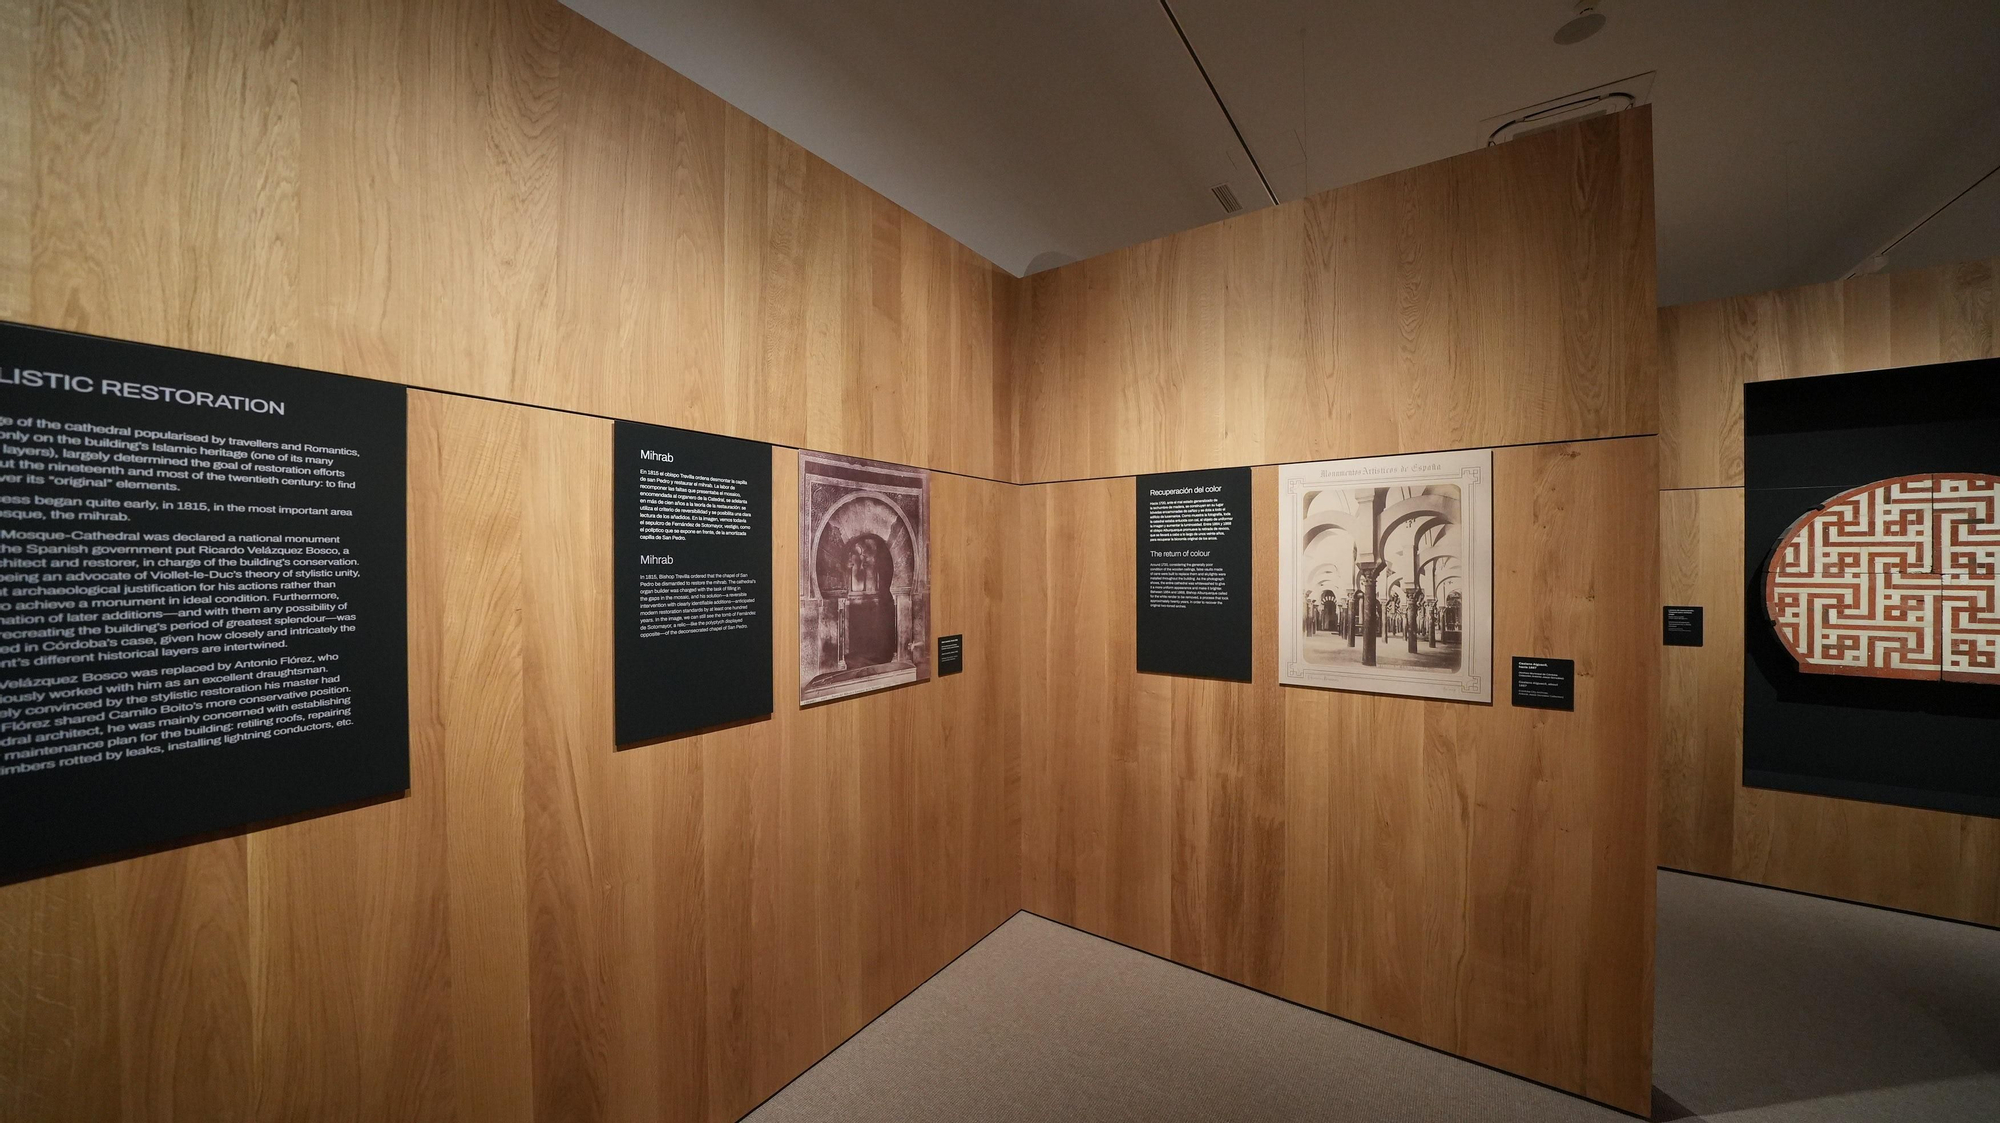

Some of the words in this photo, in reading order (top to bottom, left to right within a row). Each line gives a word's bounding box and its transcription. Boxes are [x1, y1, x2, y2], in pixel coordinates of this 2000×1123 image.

[102, 379, 285, 415] RESTORATION
[17, 417, 33, 427] of
[36, 419, 61, 430] the
[64, 423, 131, 436] cathedral
[134, 430, 209, 443] popularised
[212, 435, 226, 446] by
[228, 437, 279, 449] travellers
[281, 443, 302, 451] and
[304, 444, 360, 457] Romantics,
[3, 444, 59, 458] layers),
[63, 448, 111, 463] largely
[113, 453, 188, 466] determined
[191, 458, 211, 468] the
[213, 461, 238, 470] goal
[240, 462, 252, 470] of
[254, 465, 312, 475] restoration
[313, 465, 345, 477] efforts
[33, 434, 54, 443] on
[57, 434, 81, 445] the
[84, 436, 150, 452] building's
[153, 443, 197, 454] Islamic
[200, 446, 248, 460] heritage
[250, 451, 276, 461] (one
[277, 453, 289, 461] of
[290, 454, 303, 462] its
[305, 457, 334, 467] many
[640, 449, 674, 463] Mihrab
[19, 460, 45, 470] the
[48, 462, 125, 475] nineteenth
[128, 468, 154, 477] and
[156, 470, 189, 479] most
[192, 471, 204, 480] of
[206, 472, 226, 481] the
[228, 474, 279, 484] twentieth
[281, 478, 323, 488] century:
[326, 480, 336, 488] to
[338, 480, 356, 489] find
[26, 474, 45, 484] its
[49, 476, 113, 488] "original"
[116, 479, 180, 491] elements.
[1150, 487, 1193, 496] Recuperación
[1194, 486, 1204, 494] del
[1205, 485, 1222, 493] color
[35, 495, 83, 508] began
[86, 498, 121, 509] quite
[124, 500, 159, 511] early,
[162, 500, 174, 509] in
[177, 501, 210, 512] 1815,
[214, 503, 224, 511] in
[227, 503, 246, 512] the
[248, 506, 276, 514] most
[279, 505, 328, 515] important
[50, 510, 75, 520] the
[78, 511, 131, 521] mihrab.
[0, 529, 140, 541] Mosque-Cathedral
[173, 533, 226, 542] declared
[239, 534, 282, 543] national
[26, 544, 89, 555] Spanish
[92, 546, 173, 556] government
[175, 546, 196, 556] put
[199, 546, 245, 554] Ricardo
[247, 546, 303, 555] Velázquez
[306, 547, 341, 555] Bosco,
[640, 554, 674, 565] Mihrab
[82, 671, 128, 682] Bosco
[131, 669, 158, 678] was
[161, 662, 215, 676] replaced
[217, 662, 232, 671] by
[234, 658, 278, 669] Antonio
[280, 656, 315, 665] Flórez,
[318, 653, 339, 661] who
[59, 752, 102, 767] rotted
[106, 751, 123, 761] by
[126, 745, 165, 757] leaks,
[168, 736, 222, 751] installing
[224, 729, 272, 744] lightning
[273, 722, 334, 736] conductors,
[336, 719, 354, 727] etc.
